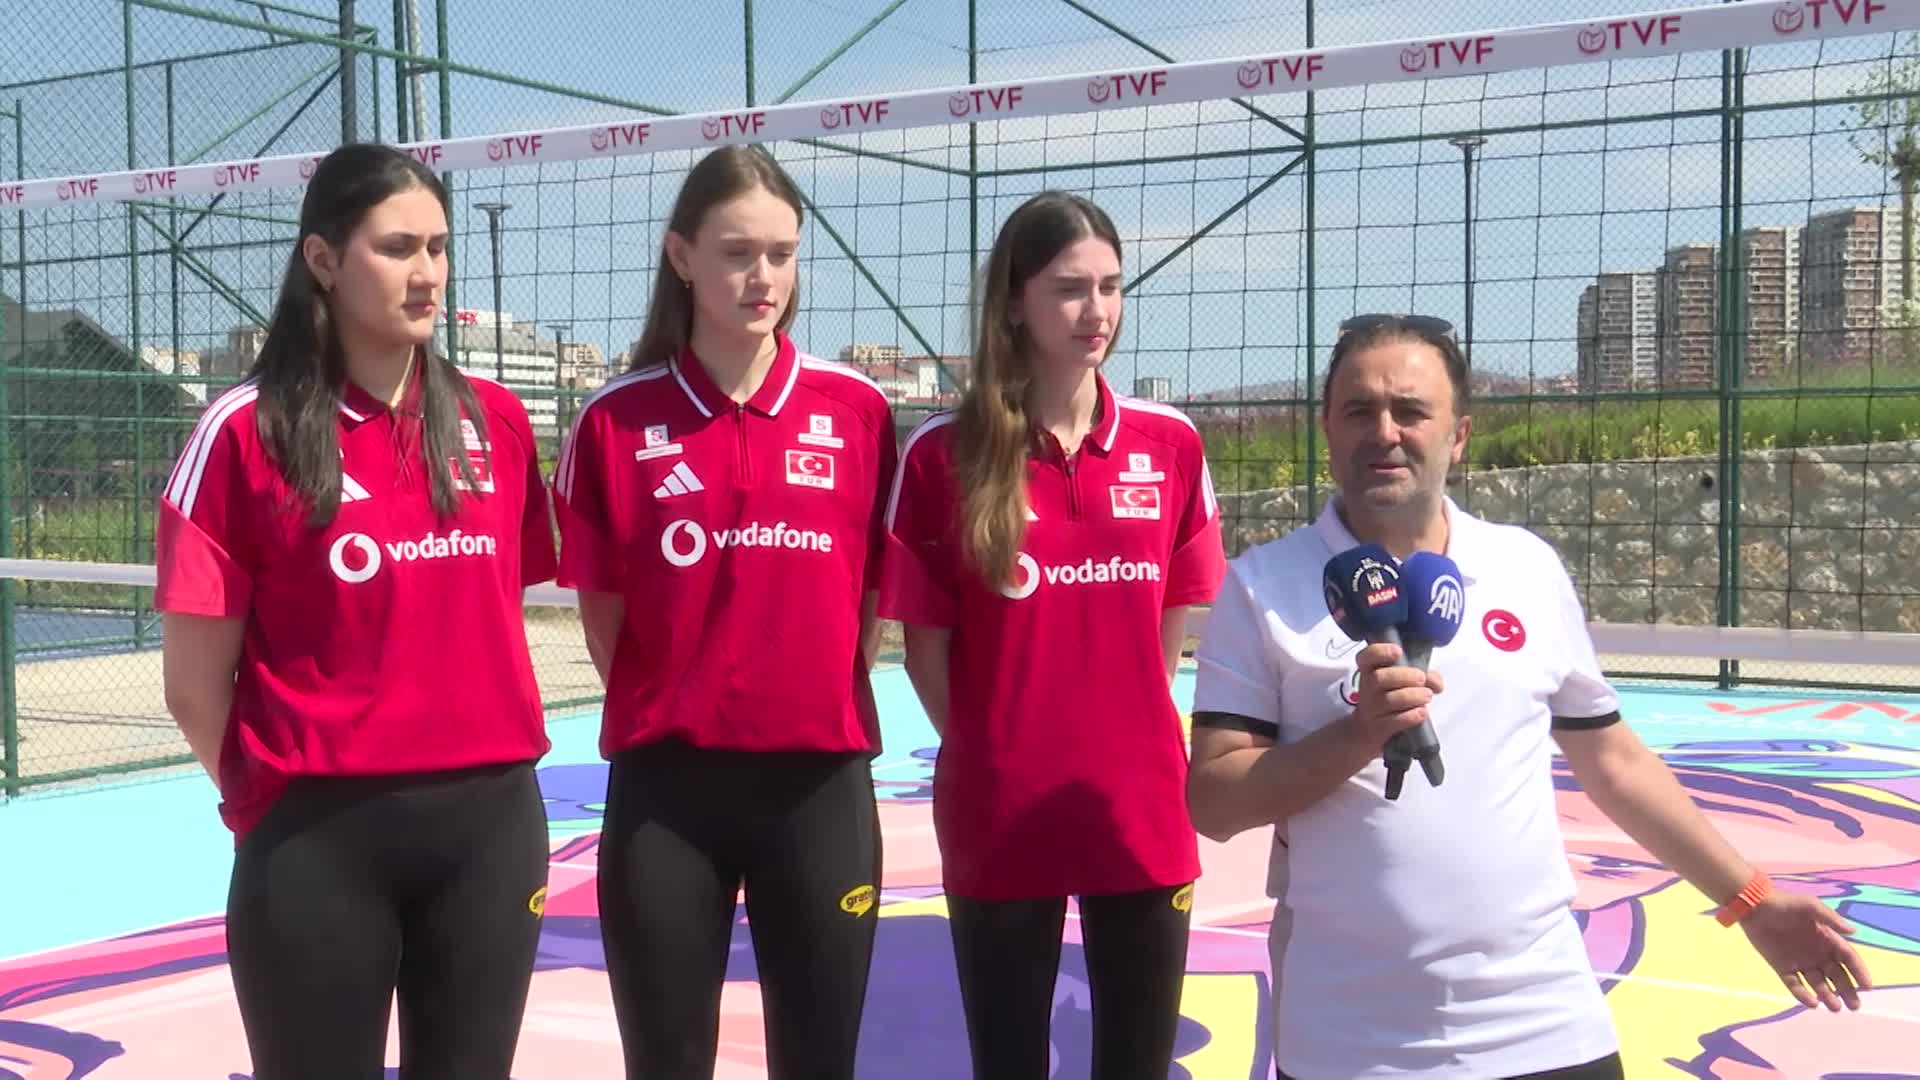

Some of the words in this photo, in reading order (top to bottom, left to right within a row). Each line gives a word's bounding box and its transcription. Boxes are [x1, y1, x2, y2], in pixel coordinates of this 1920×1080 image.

[1806, 0, 1886, 29] TVF
[1608, 16, 1681, 49] TVF
[1428, 36, 1495, 68] TVF
[1262, 55, 1325, 84] TVF
[1110, 71, 1168, 99] TVF
[840, 100, 889, 126] TVF
[970, 87, 1023, 114] TVF
[607, 124, 650, 149] TVF
[720, 113, 766, 138] TVF
[502, 135, 543, 158] TVF
[145, 172, 177, 190] TVF
[227, 164, 260, 185] TVF
[69, 179, 98, 198] TVF
[712, 521, 832, 553] vodafone
[1427, 585, 1460, 624] AA
